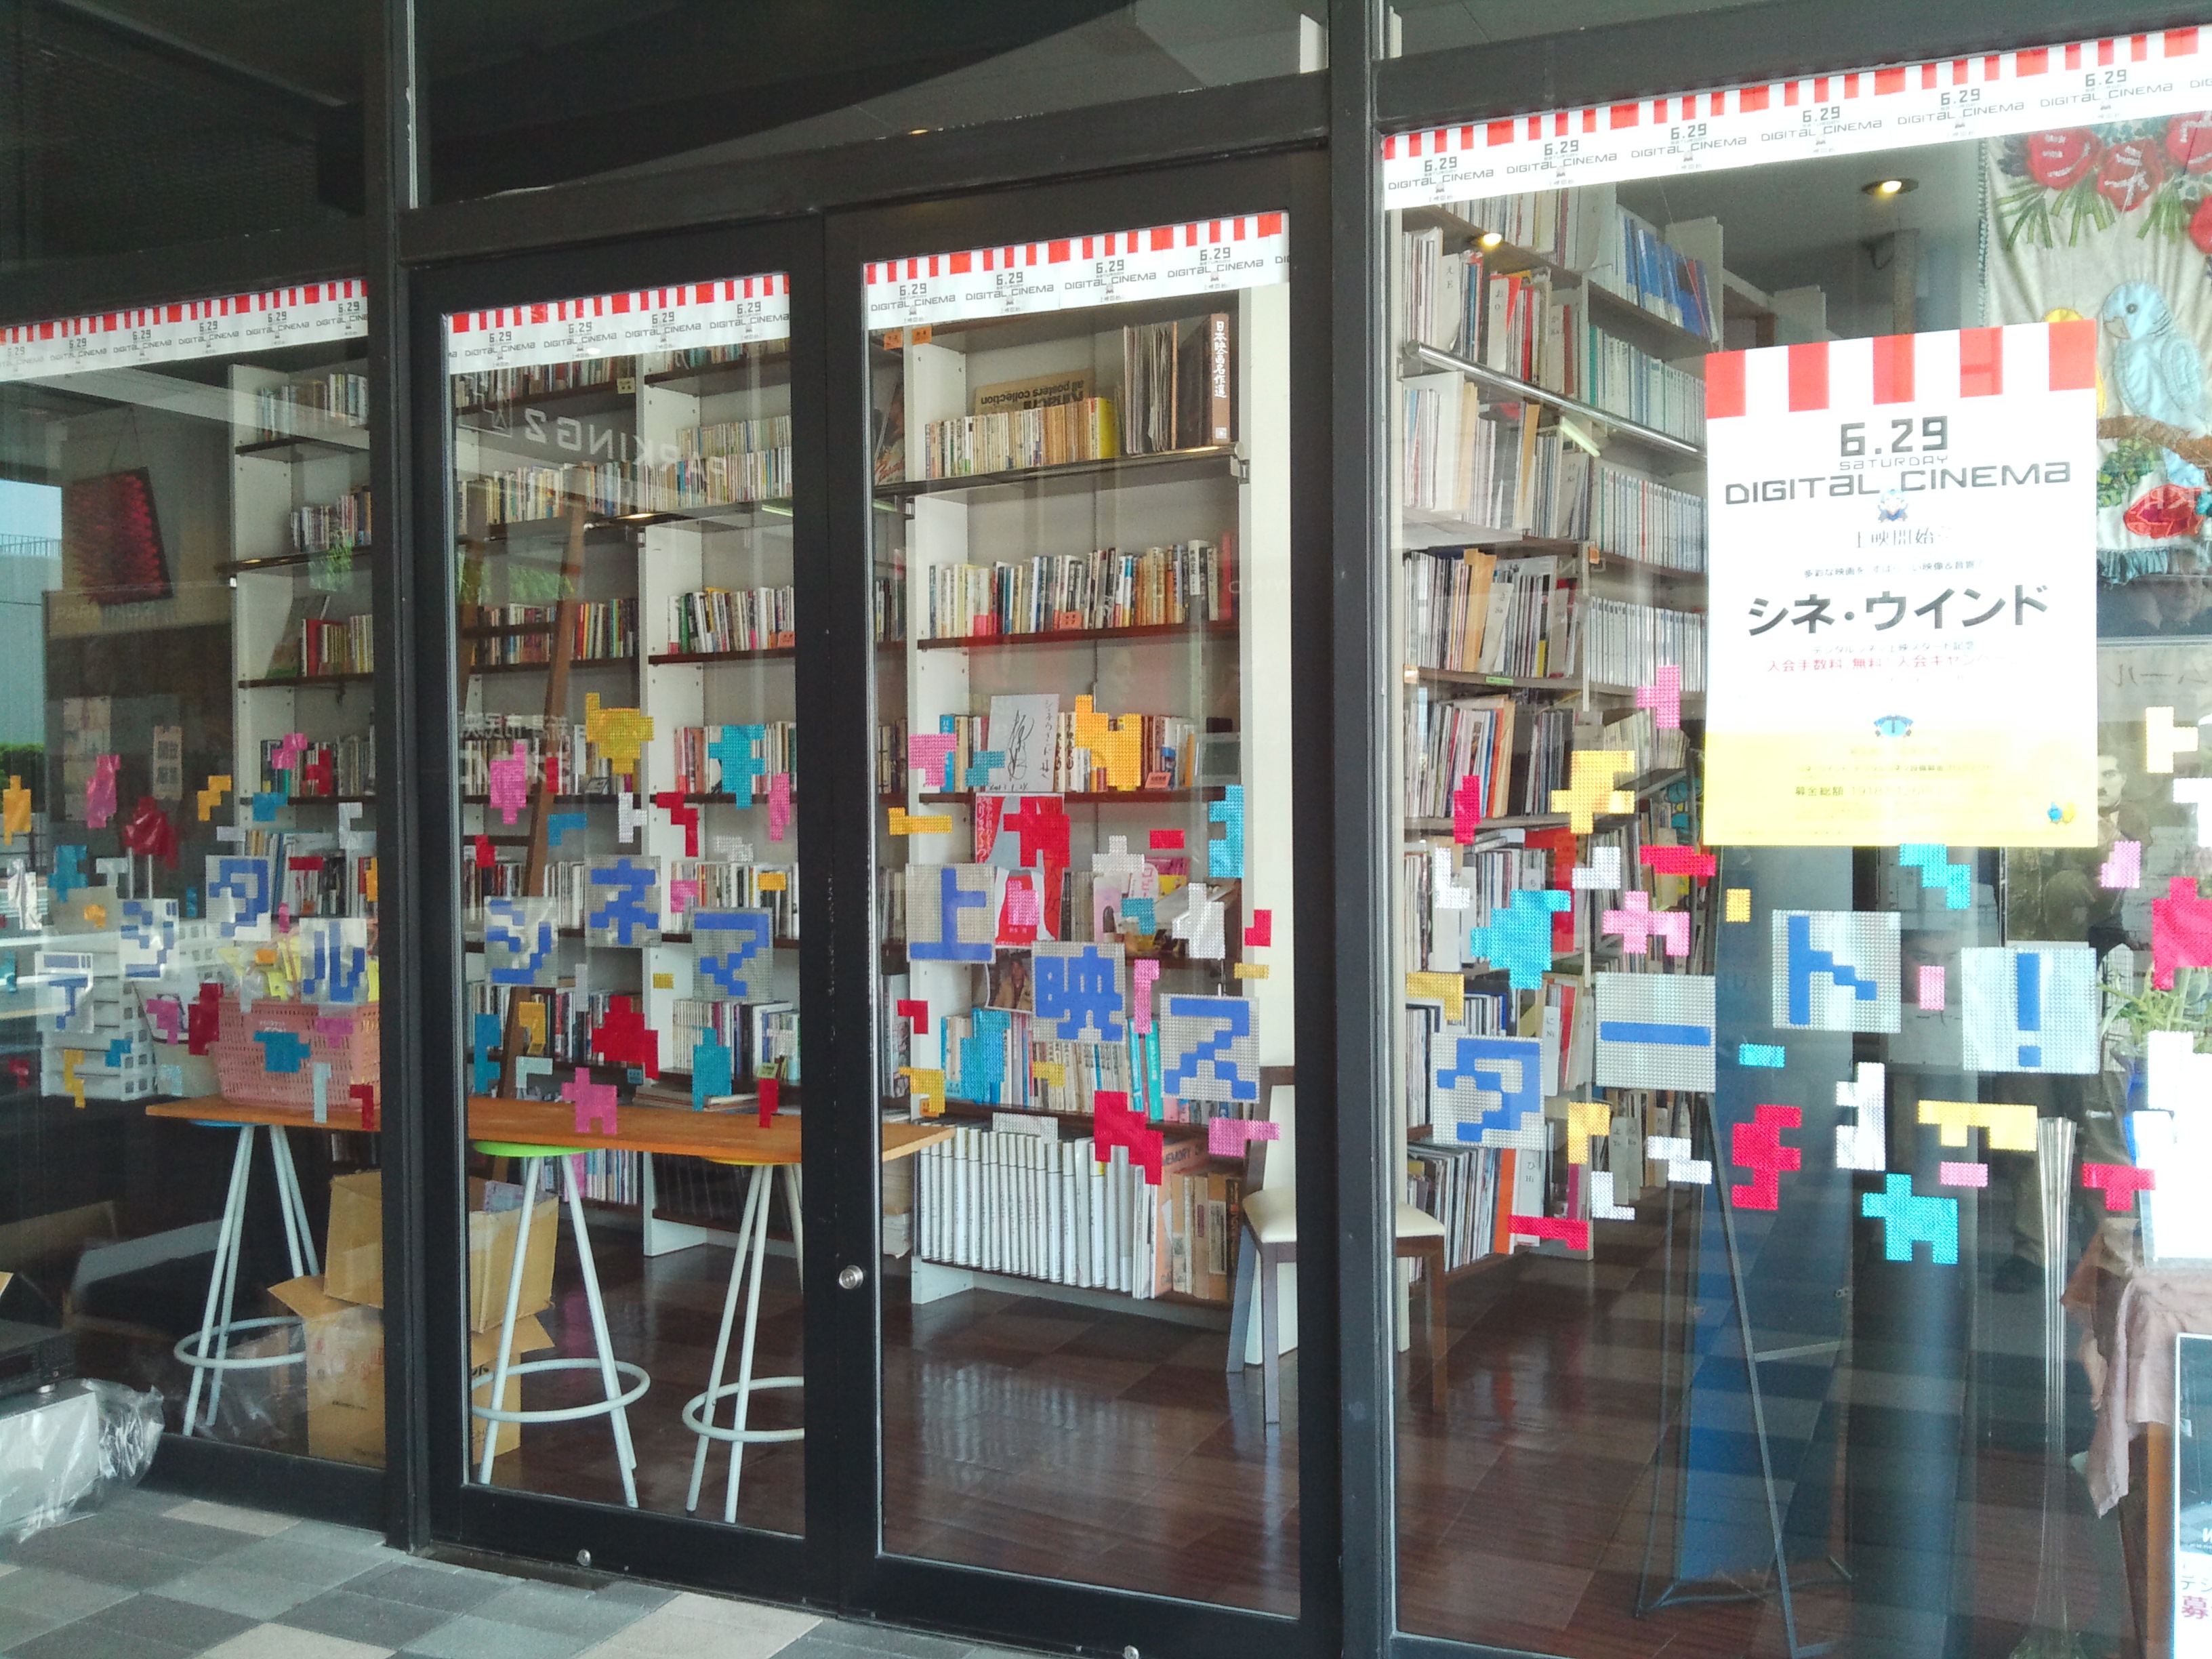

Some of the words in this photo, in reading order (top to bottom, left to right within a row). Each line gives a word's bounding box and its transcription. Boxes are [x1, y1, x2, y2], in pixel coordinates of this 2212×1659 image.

[2085, 70, 2126, 87] 6.29
[1941, 89, 1980, 105] 6.29
[1803, 106, 1840, 123] 6.29
[1671, 123, 1706, 140] 6.29
[1544, 140, 1578, 156] 6.29
[1425, 157, 1457, 172] 6.29
[1200, 247, 1230, 262] 6.29
[1096, 260, 1124, 274] 6.29
[996, 272, 1023, 285] 6.29
[899, 283, 927, 296] 6.29
[338, 301, 359, 312] 6.29
[737, 302, 761, 314] 6.29
[267, 311, 287, 323] 6.29
[652, 312, 674, 324] 6.29
[569, 322, 592, 333] 6.29
[489, 331, 512, 343] 6.29
[981, 390, 1031, 405] collection
[1029, 382, 1070, 399] posters
[1841, 415, 1948, 457] 6.29
[1748, 583, 2048, 637] シネ・ウインド
